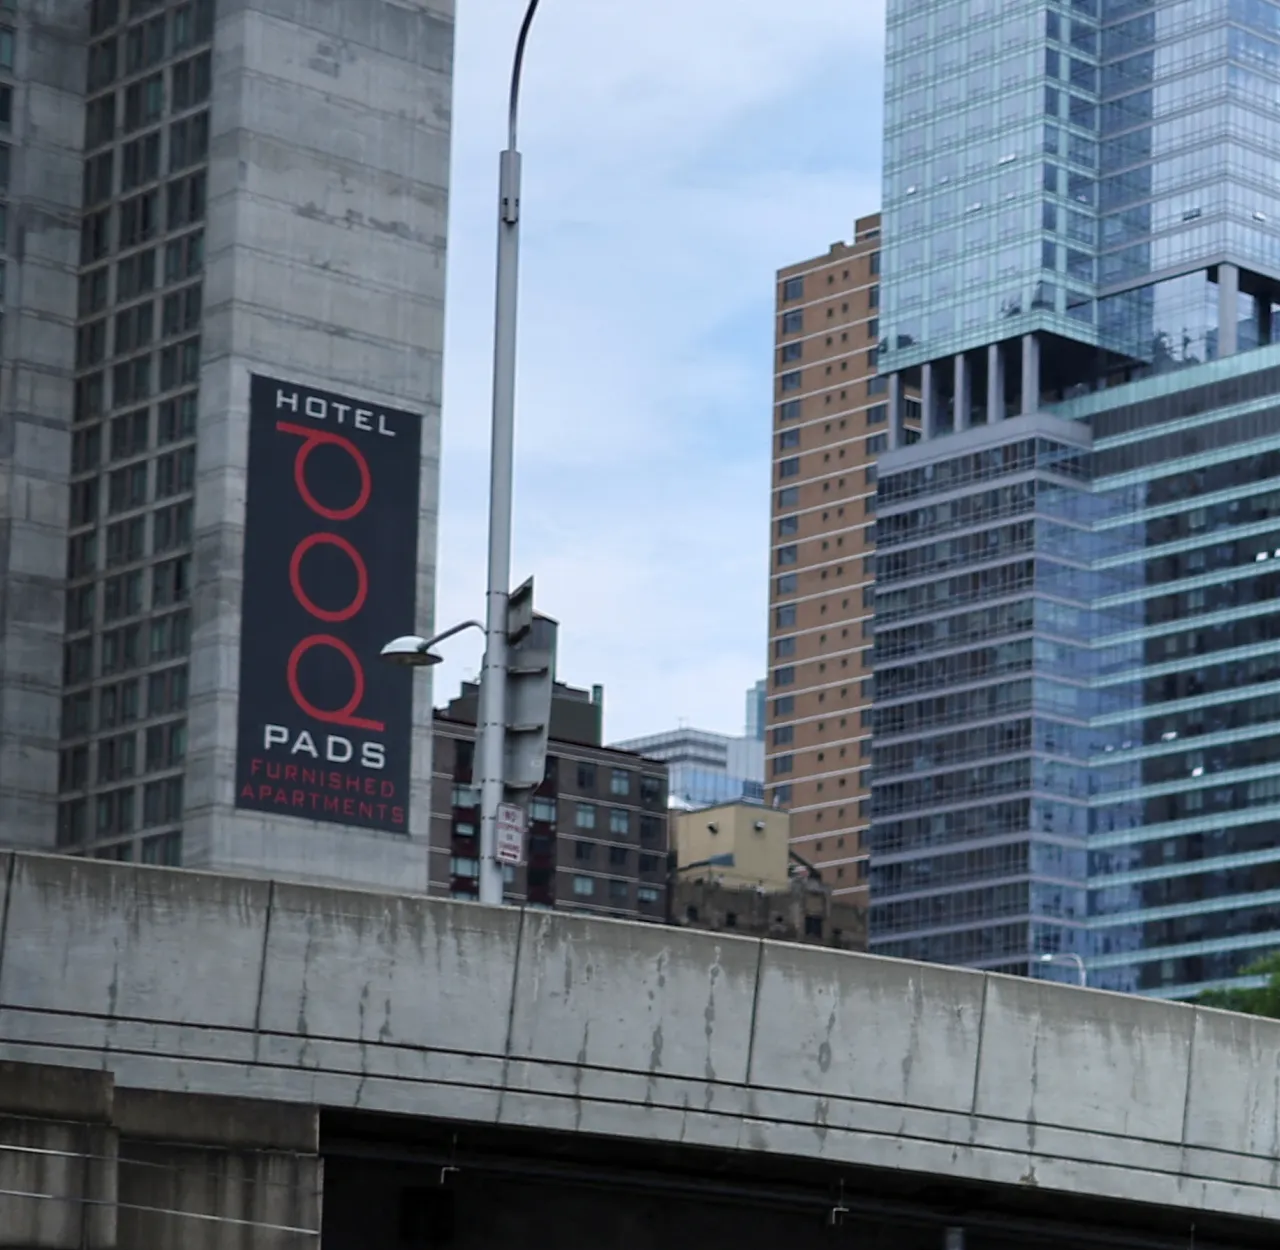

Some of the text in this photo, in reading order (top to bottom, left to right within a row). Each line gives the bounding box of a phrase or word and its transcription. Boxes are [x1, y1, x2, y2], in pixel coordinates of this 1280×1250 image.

[275, 389, 396, 437] HOTEL
[264, 723, 386, 769] PADS
[251, 758, 395, 798] FURNISHED
[240, 783, 405, 824] APARTMENTS
